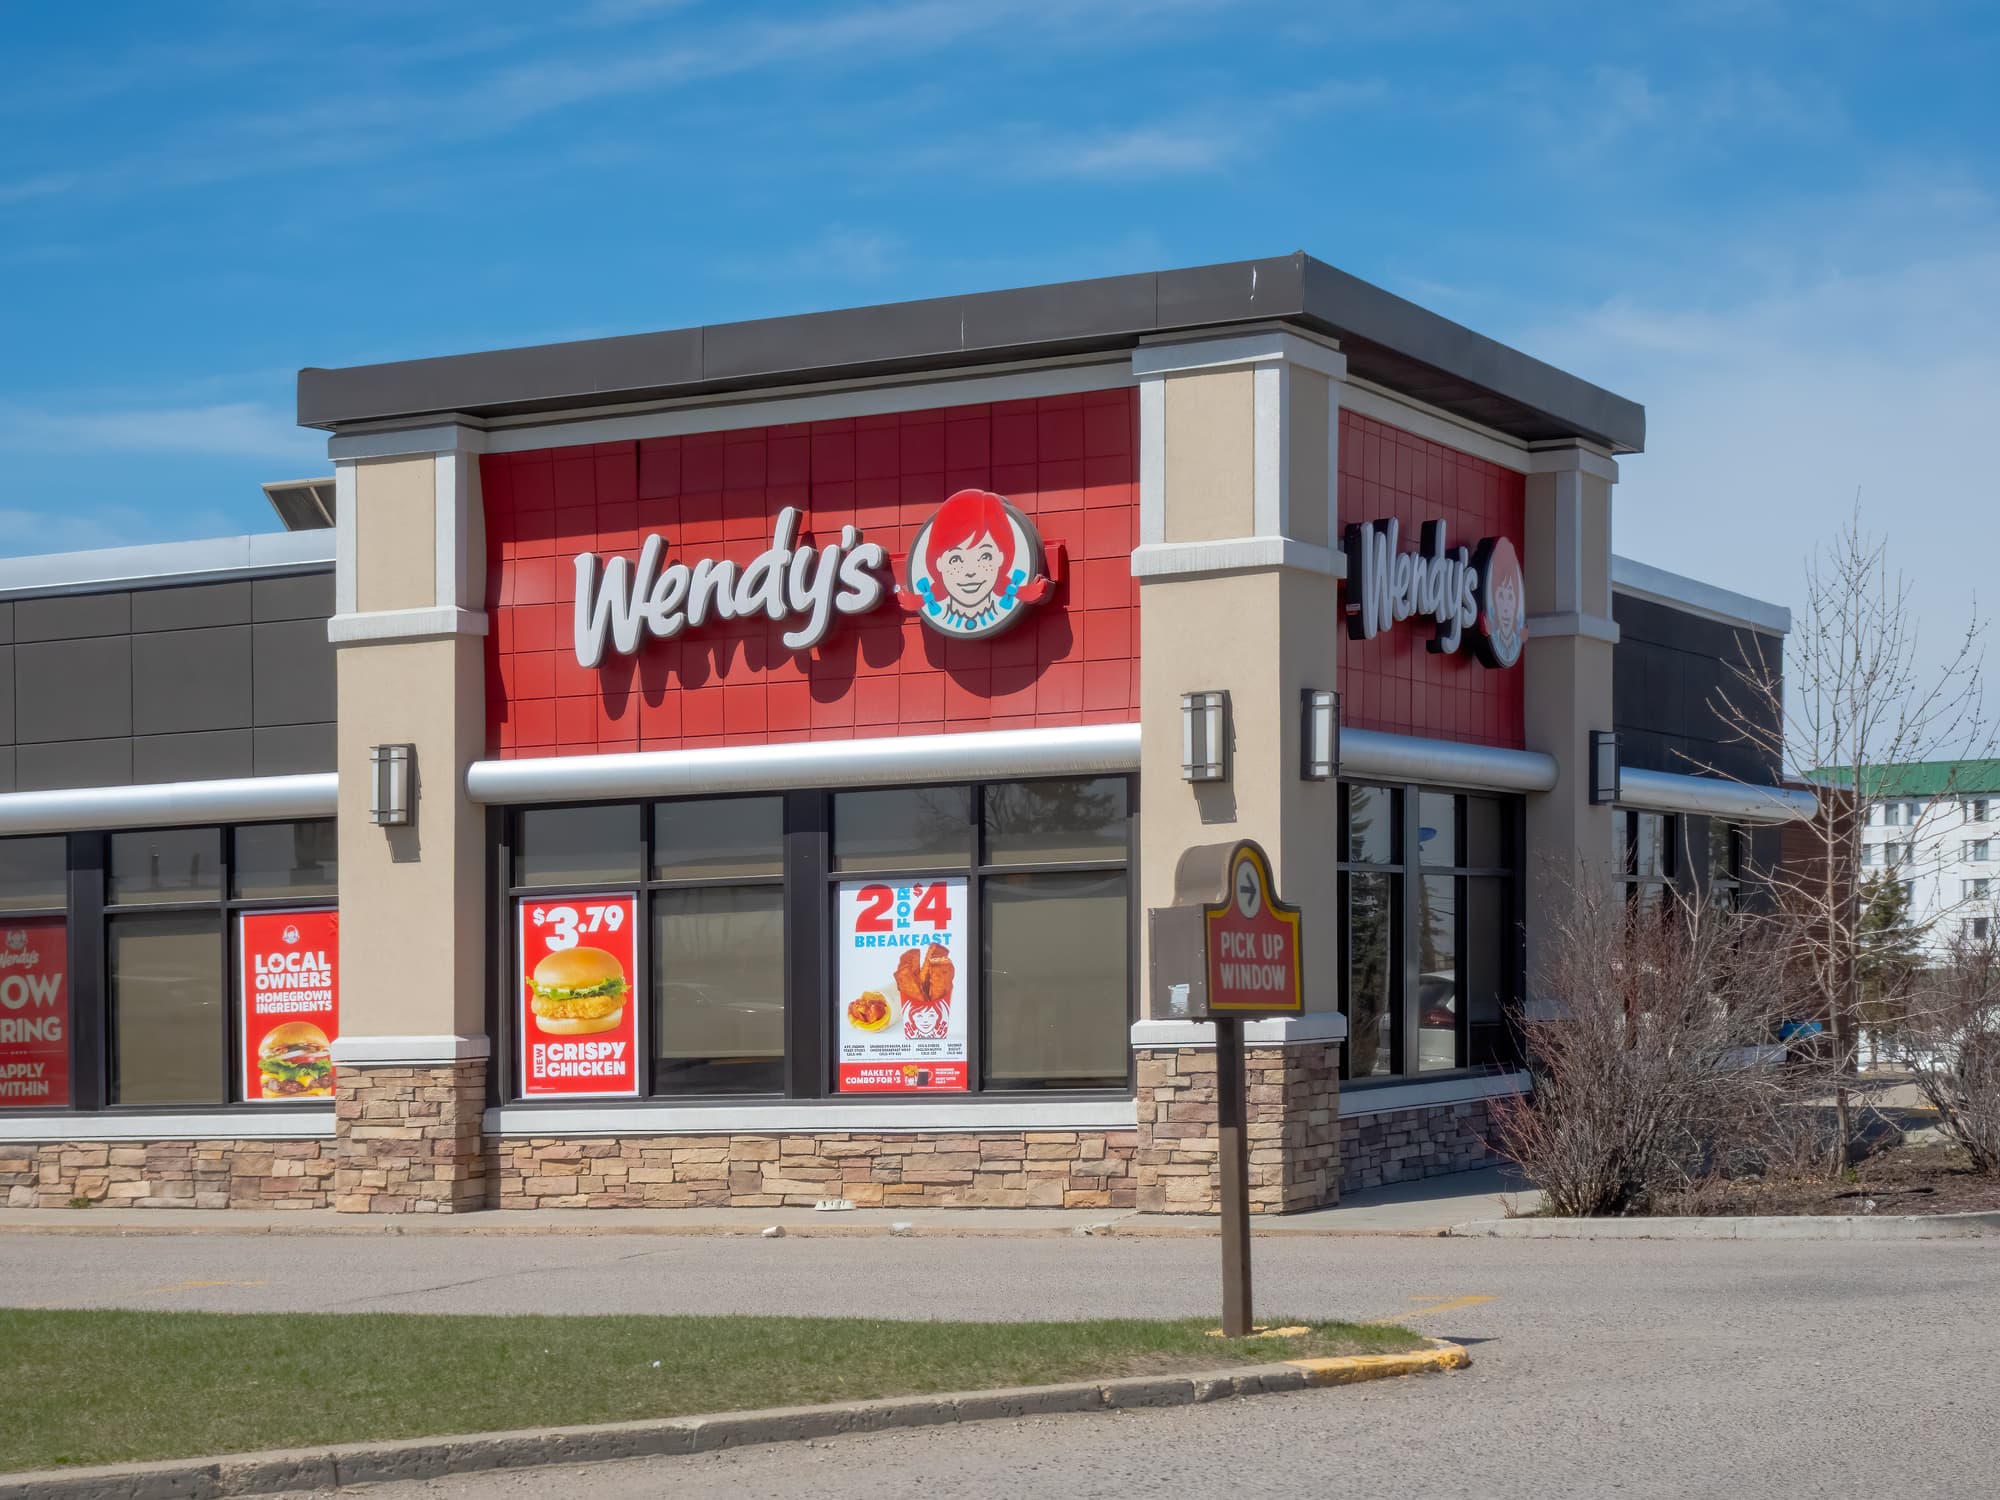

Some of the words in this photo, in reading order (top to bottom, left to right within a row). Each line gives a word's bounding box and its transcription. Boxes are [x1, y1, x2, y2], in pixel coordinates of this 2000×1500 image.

[573, 506, 887, 669] Wendy's
[1360, 516, 1478, 654] Wendy's
[855, 883, 895, 933] 2
[897, 886, 911, 929] FOR
[912, 881, 952, 931] $4
[532, 905, 625, 952] $3.79
[854, 932, 952, 948] BREAKFAST
[1220, 931, 1257, 959] PICK
[1261, 933, 1284, 960] UP
[255, 950, 332, 974] LOCAL
[255, 971, 332, 990] OWNERS
[1219, 962, 1286, 992] WINDOW
[0, 973, 63, 1010] OW
[255, 990, 332, 1003] HOMEGROWN
[256, 1001, 332, 1014] INGREDIENTS
[0, 1016, 62, 1043] RING
[536, 1047, 545, 1075] NEW
[547, 1042, 626, 1061] CRISPY
[547, 1061, 625, 1077] CHICKEN
[845, 1076, 876, 1085] COMBO
[876, 1076, 893, 1084] FOR
[860, 1069, 884, 1077] MAKE
[885, 1069, 894, 1077] IT
